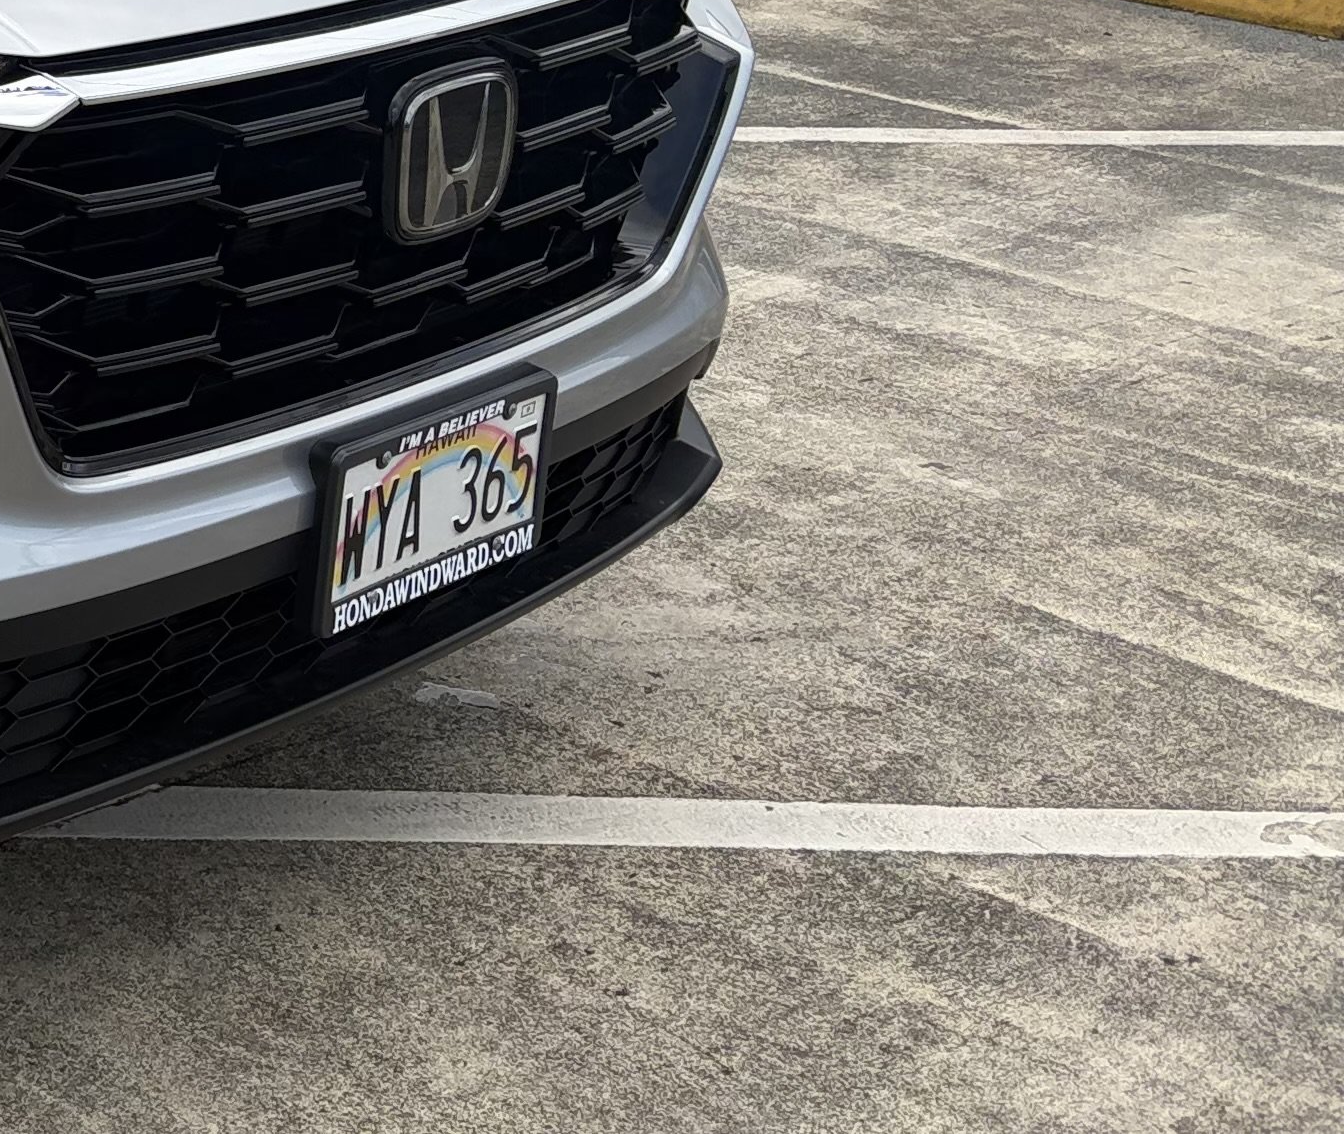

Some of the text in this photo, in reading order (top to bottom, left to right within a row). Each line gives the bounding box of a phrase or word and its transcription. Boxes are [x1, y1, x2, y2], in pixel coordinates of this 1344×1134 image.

[399, 399, 505, 453] I'M A BELIEVER
[339, 419, 538, 587] WYA 365
[332, 524, 535, 634] HONDAWINDWARD.COM
